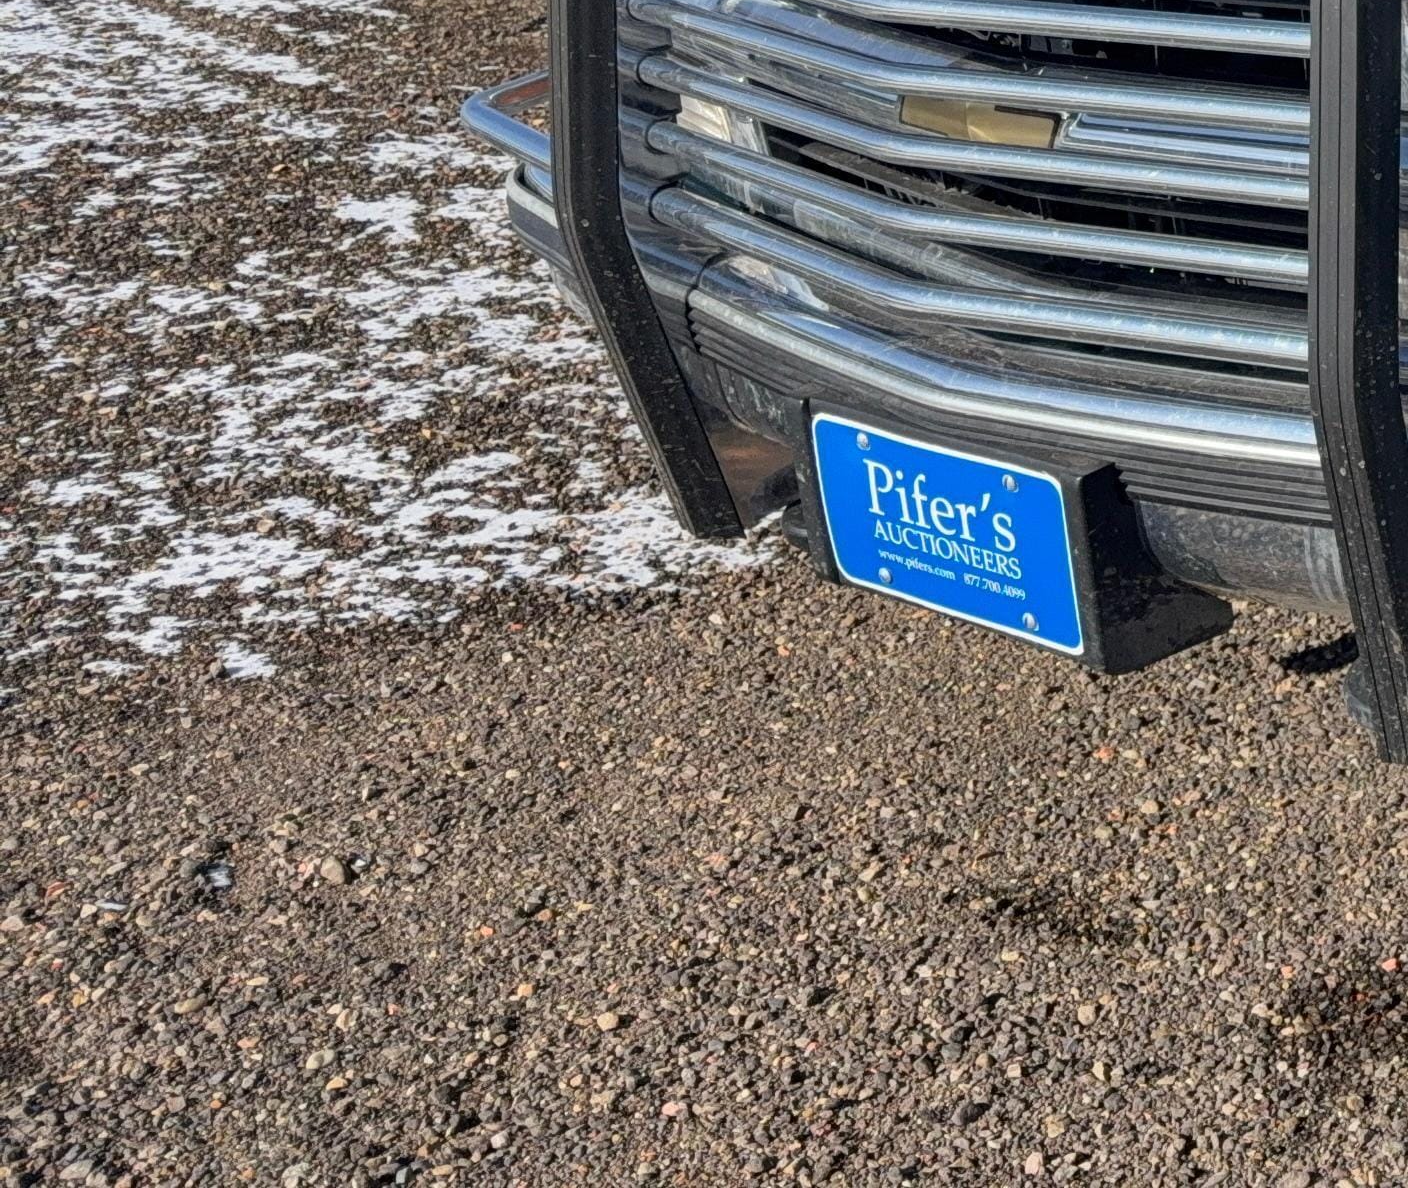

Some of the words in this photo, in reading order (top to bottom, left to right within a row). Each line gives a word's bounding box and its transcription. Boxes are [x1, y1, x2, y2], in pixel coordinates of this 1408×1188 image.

[863, 458, 1016, 552] Pifer's
[874, 519, 1022, 580] AUCTIONEERS
[878, 549, 956, 581] www.pifers.com
[963, 572, 1026, 601] 877.700.4099
